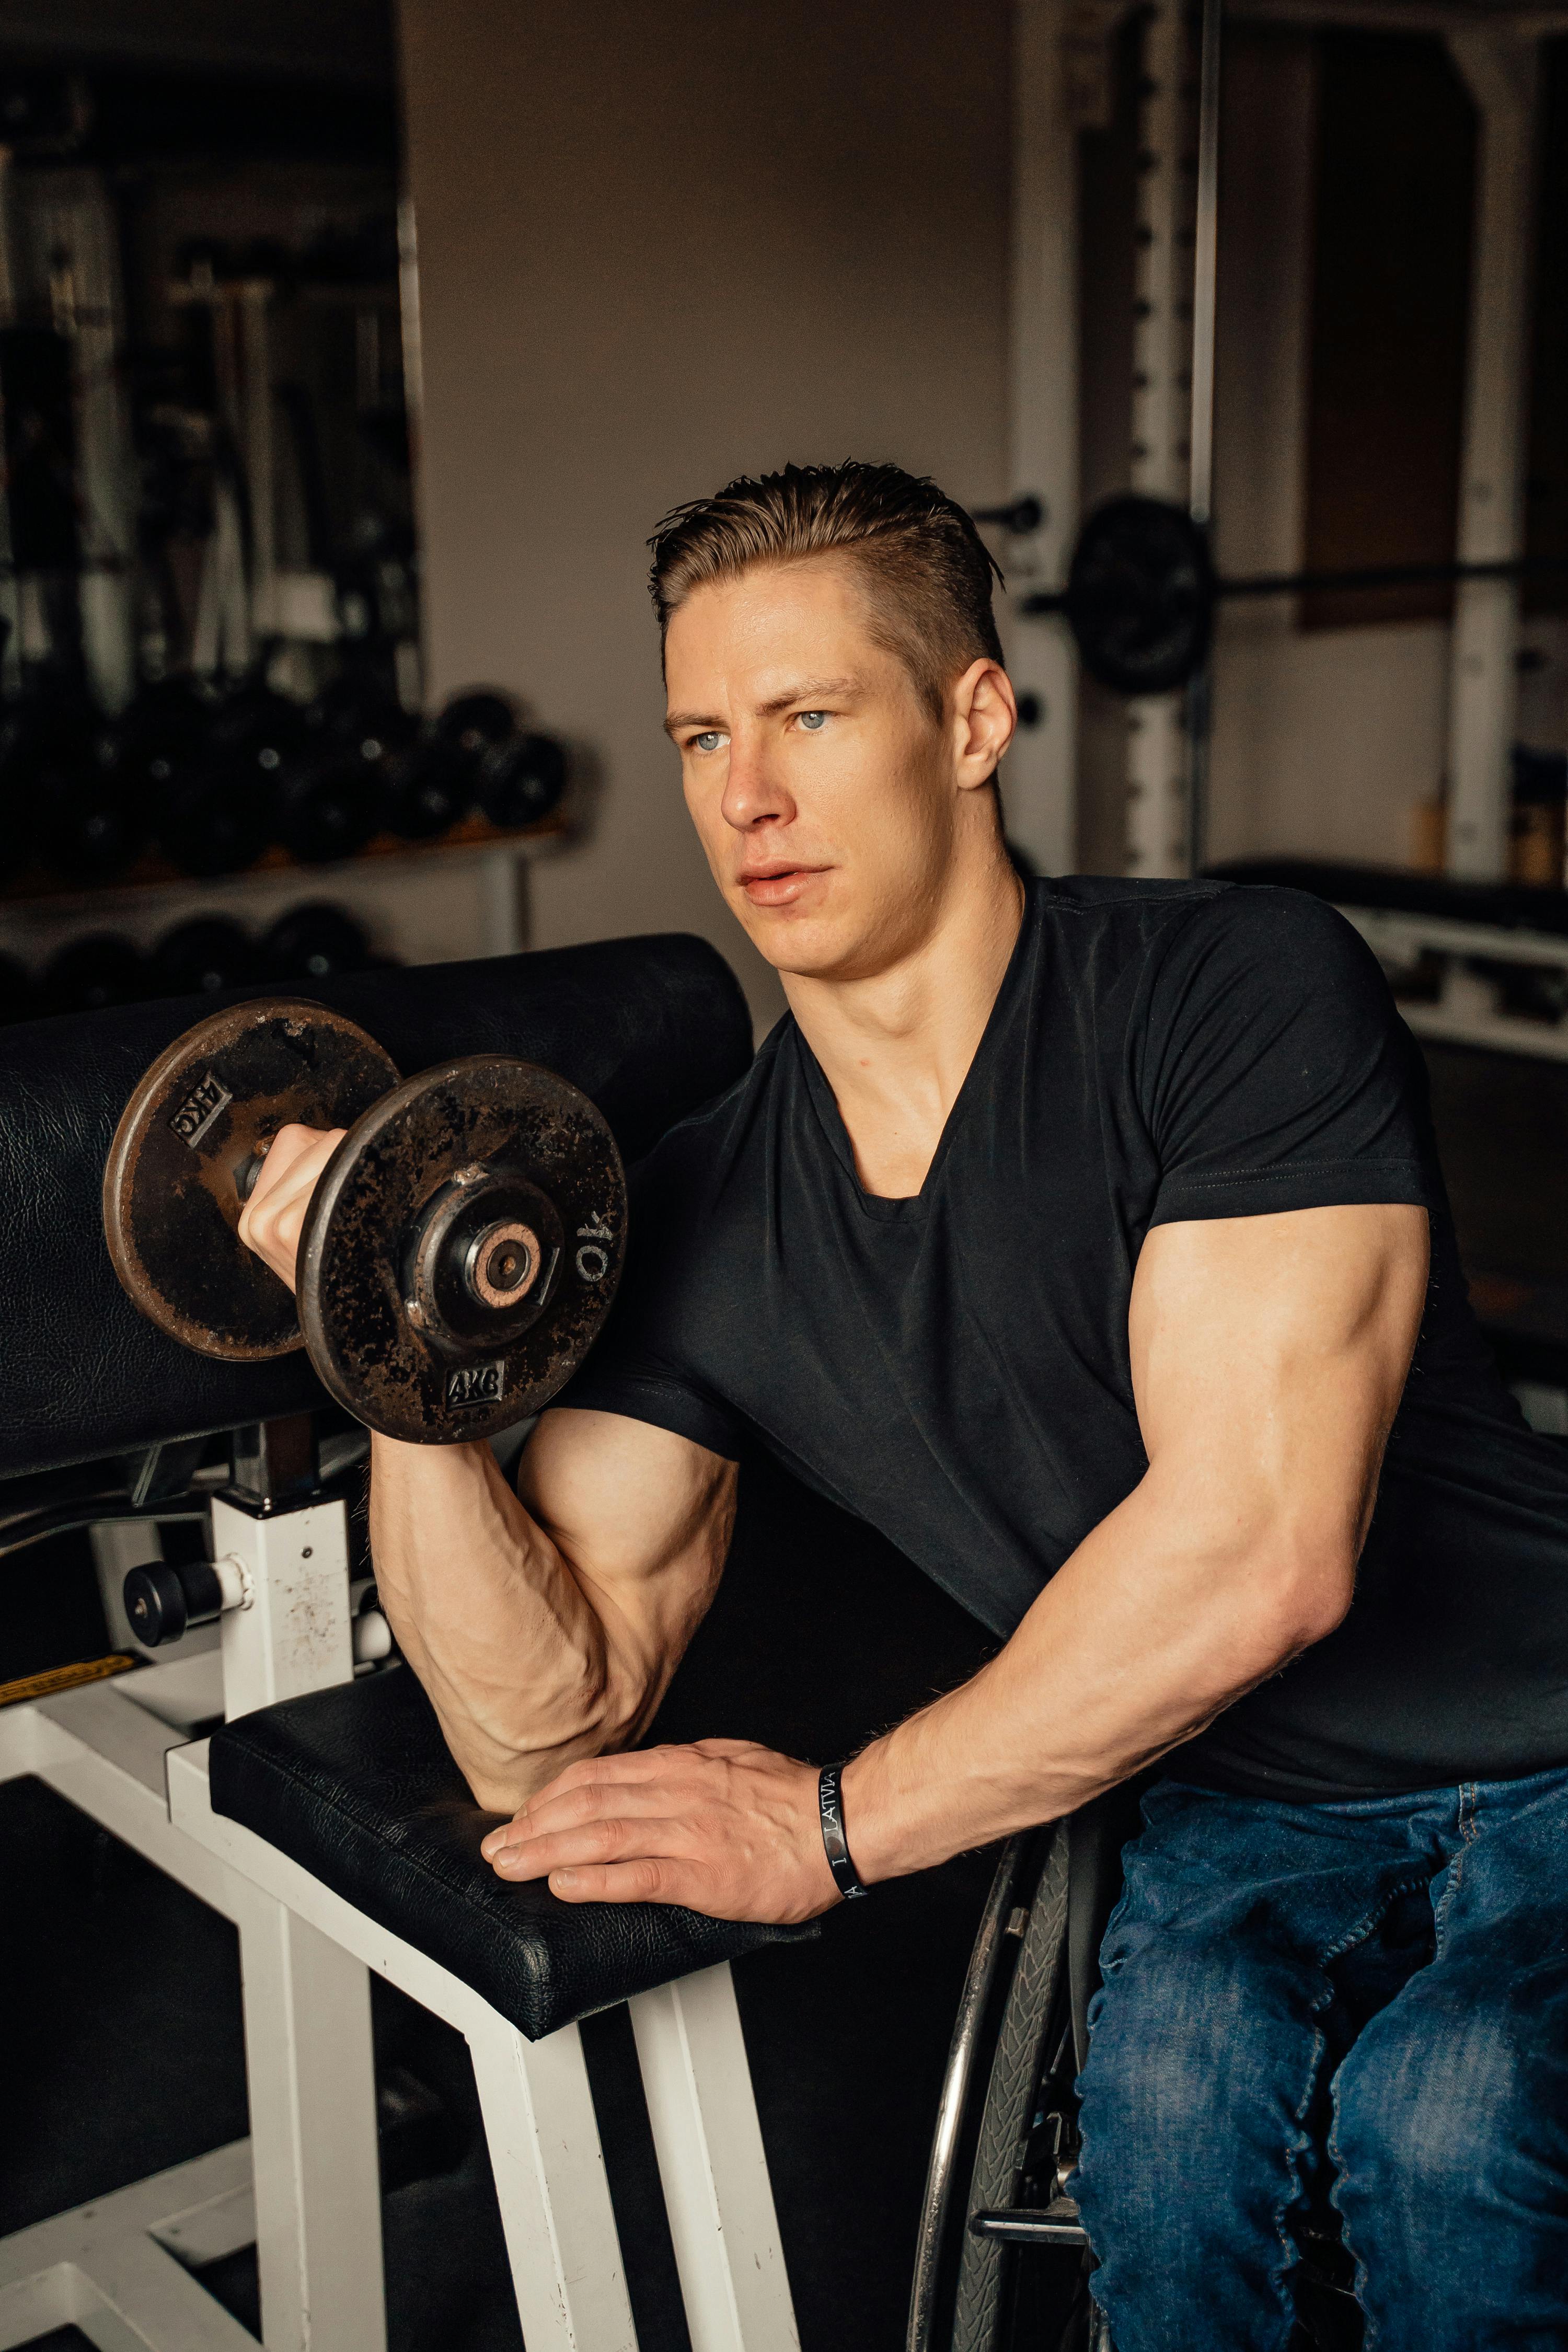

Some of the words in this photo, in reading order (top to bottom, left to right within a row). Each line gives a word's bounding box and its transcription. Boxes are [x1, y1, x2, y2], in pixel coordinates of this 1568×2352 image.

[175, 1078, 218, 1136] 4KG
[448, 1367, 498, 1403] 4KG
[821, 1771, 838, 1832] LATVIA
[832, 1857, 847, 1866] I
